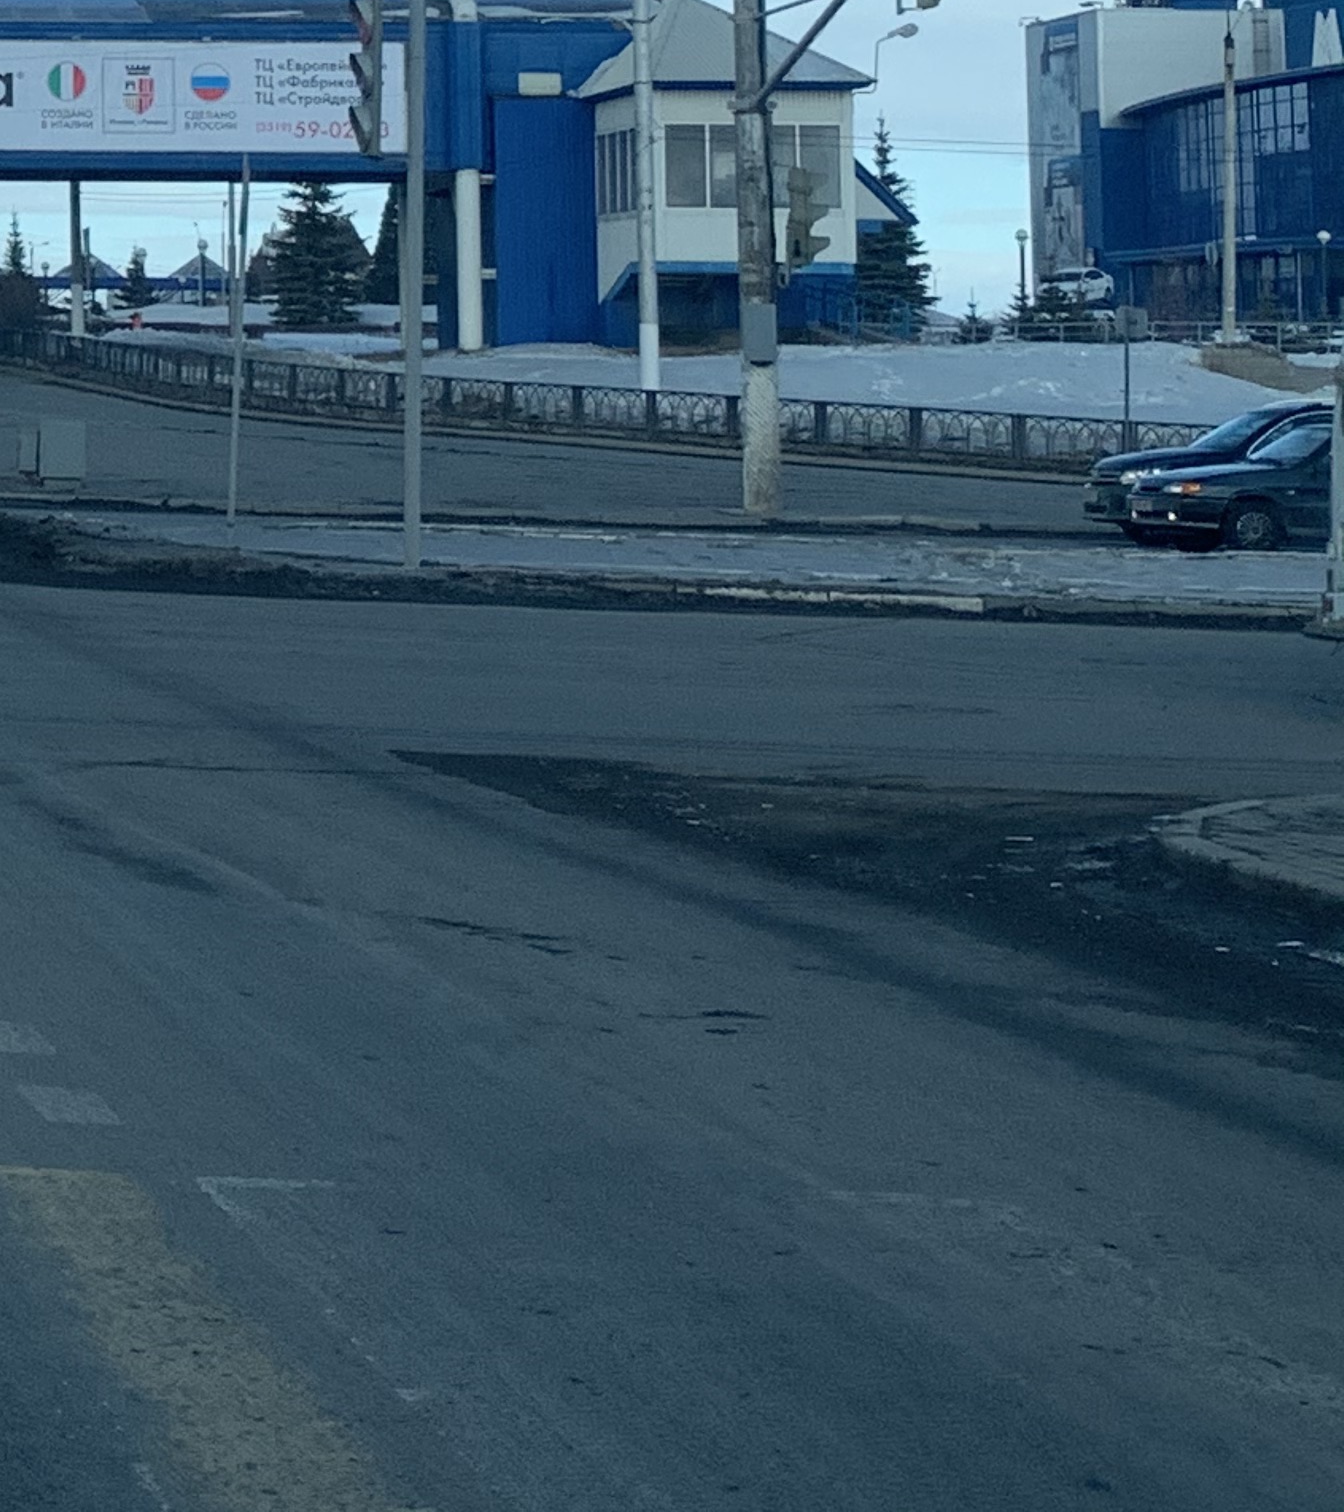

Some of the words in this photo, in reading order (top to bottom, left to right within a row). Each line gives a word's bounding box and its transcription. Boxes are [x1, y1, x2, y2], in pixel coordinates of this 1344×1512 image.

[254, 58, 274, 73] ТЦ
[254, 75, 274, 89] ТЦ
[254, 91, 274, 105] ТЦ
